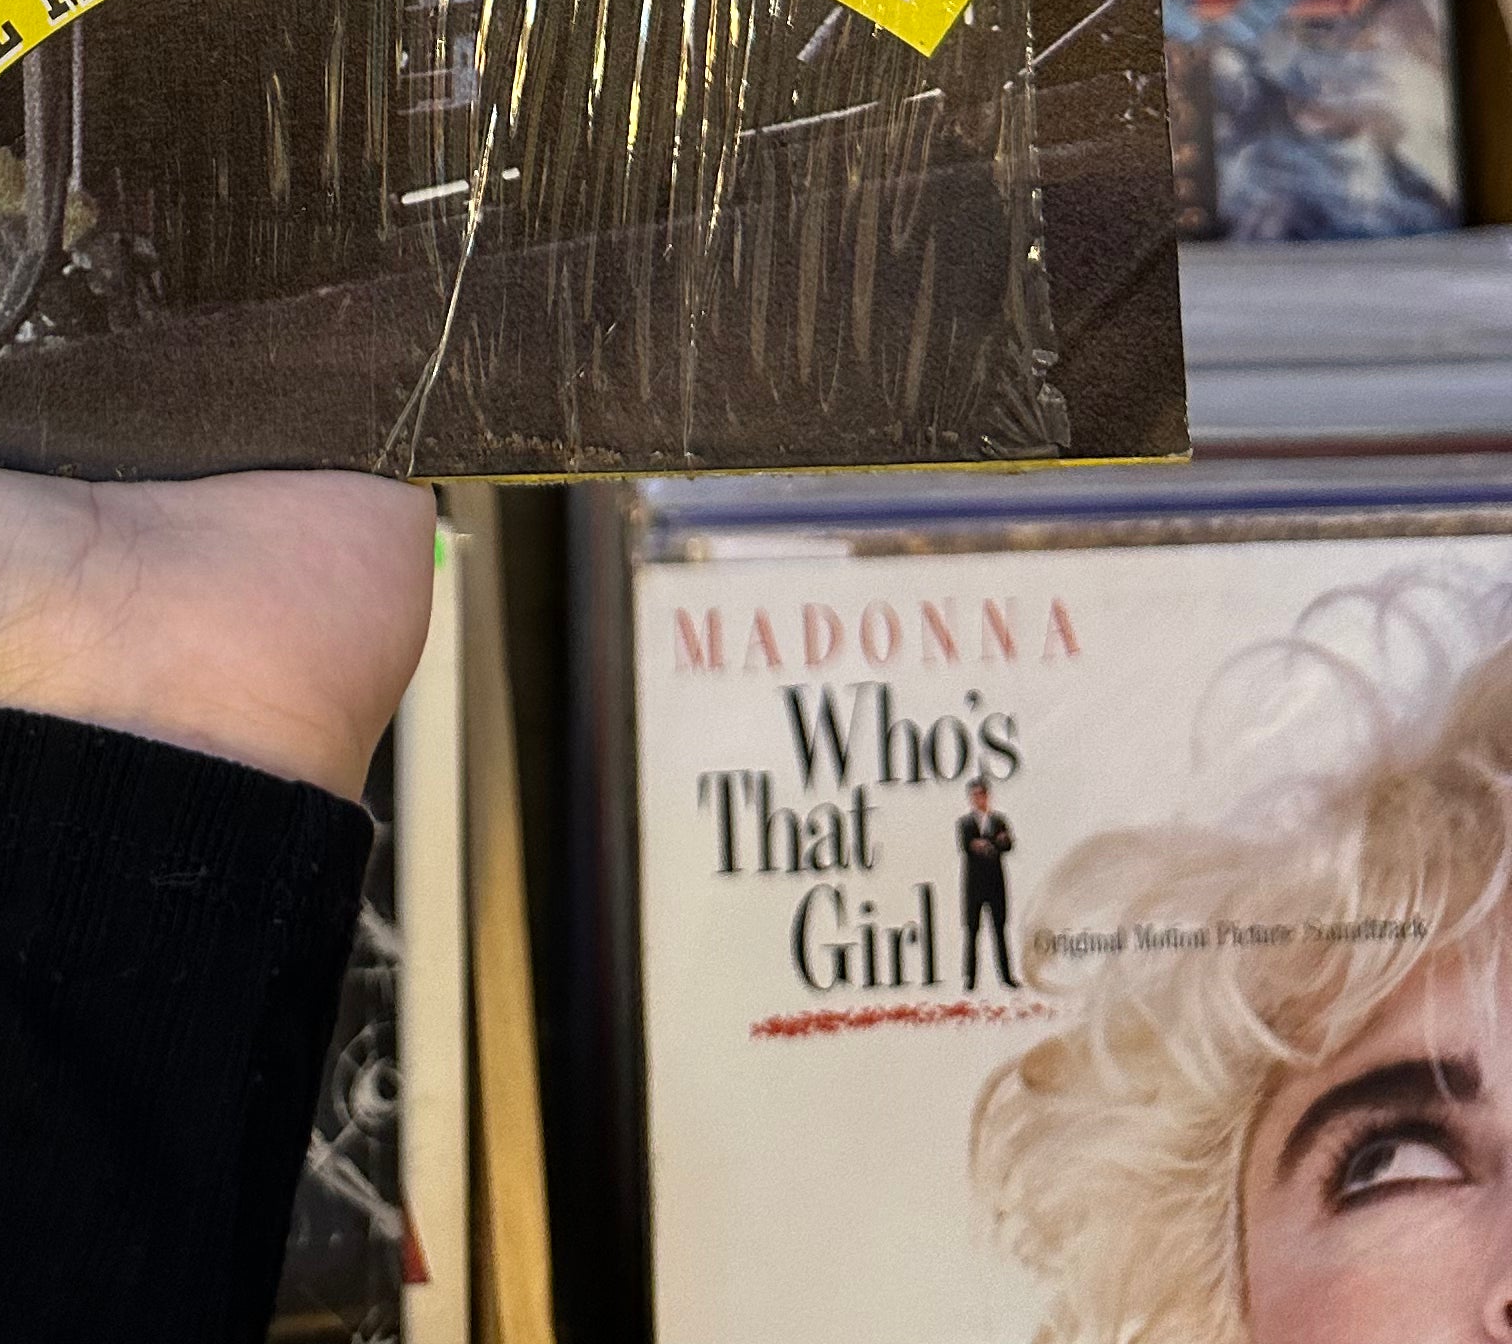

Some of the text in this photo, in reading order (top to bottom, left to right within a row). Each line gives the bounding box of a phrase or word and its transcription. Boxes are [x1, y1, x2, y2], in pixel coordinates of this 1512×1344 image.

[672, 594, 1083, 674] MADONNA
[778, 677, 1024, 792] Who's
[695, 766, 884, 875] That
[789, 879, 945, 995] Girl
[1032, 922, 1124, 957] Original
